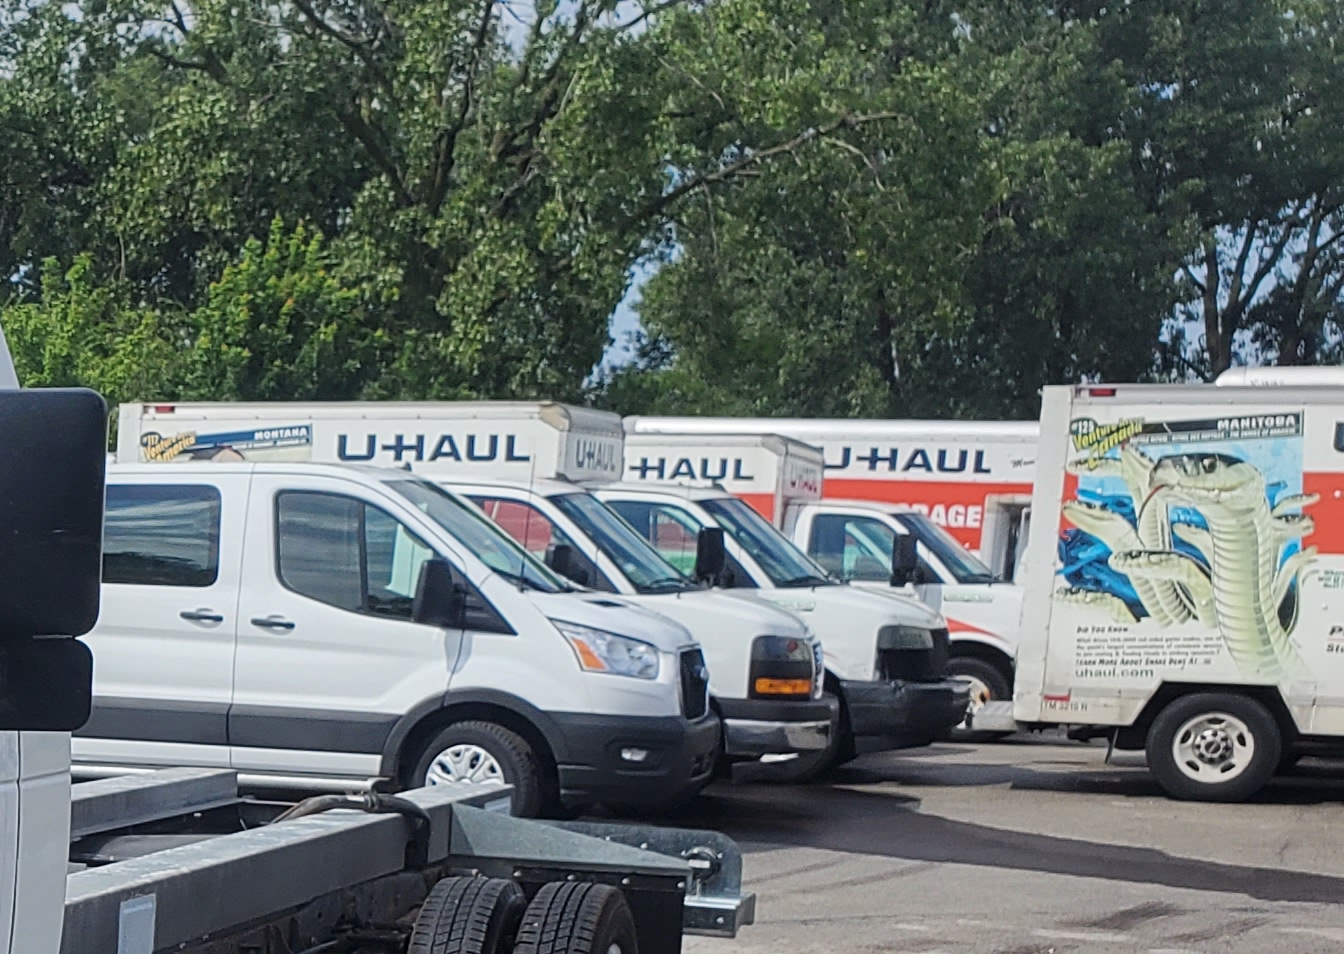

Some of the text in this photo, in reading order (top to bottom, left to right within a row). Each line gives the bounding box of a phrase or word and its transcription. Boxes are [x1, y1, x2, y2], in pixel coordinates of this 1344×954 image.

[1216, 414, 1296, 431] MANITOBA
[254, 427, 308, 441] MONTANA
[337, 434, 530, 462] U-HAUL
[629, 456, 755, 481] -HAUL
[1075, 668, 1154, 678] uhaul.com
